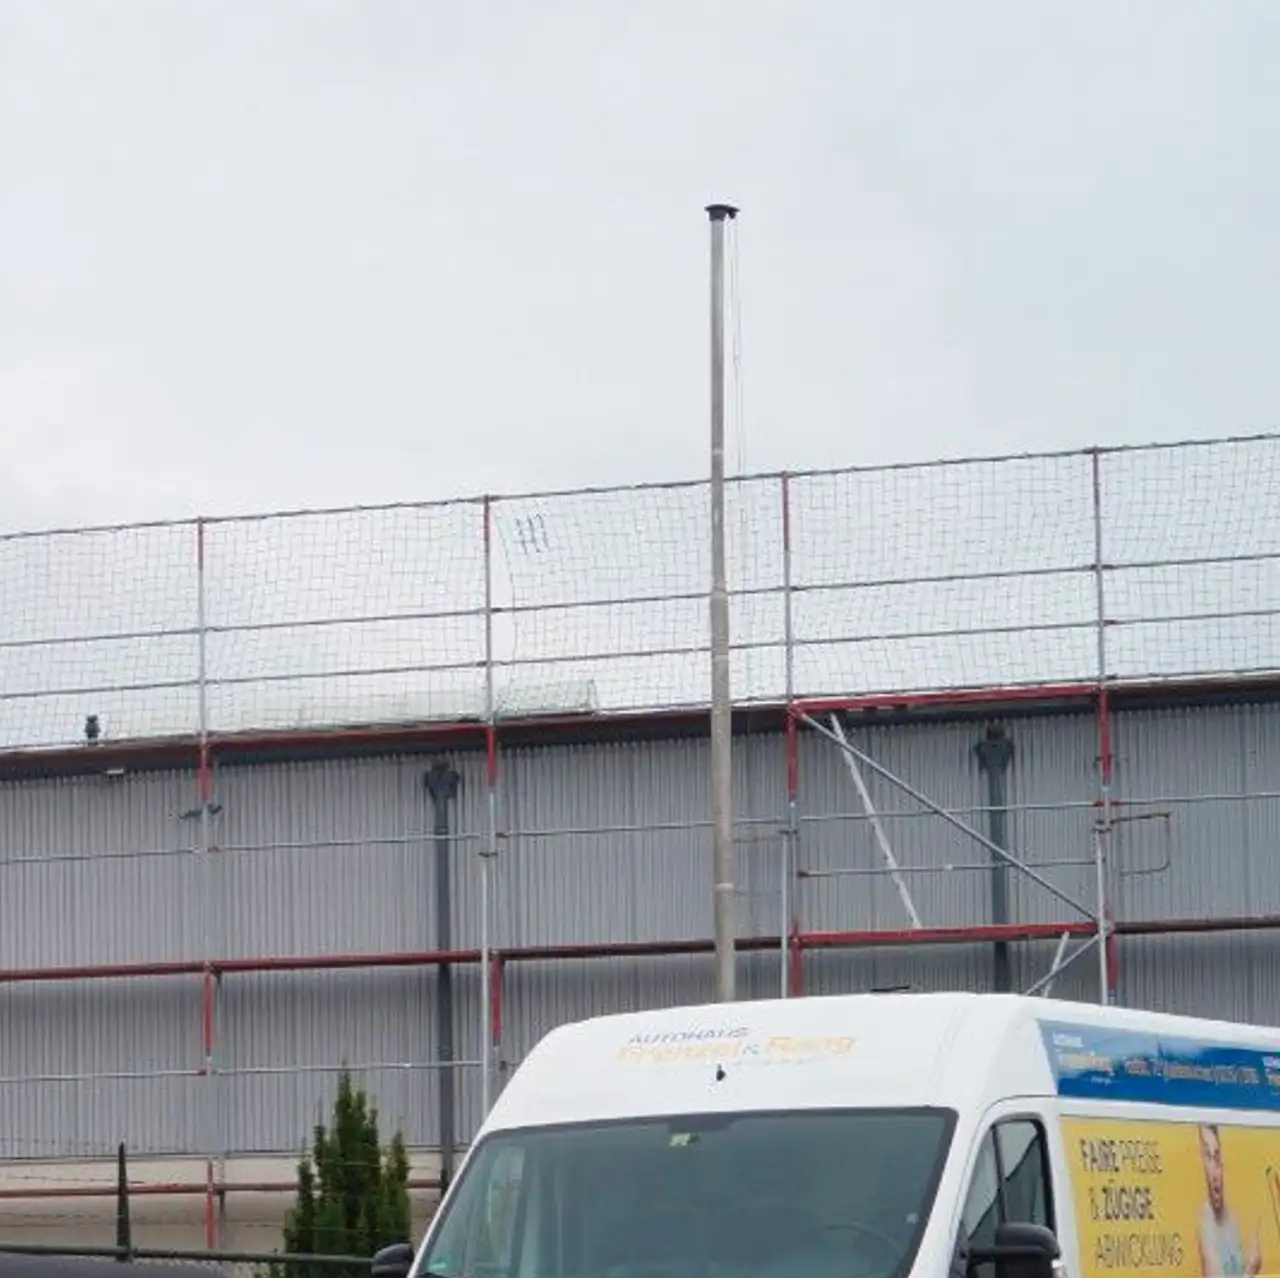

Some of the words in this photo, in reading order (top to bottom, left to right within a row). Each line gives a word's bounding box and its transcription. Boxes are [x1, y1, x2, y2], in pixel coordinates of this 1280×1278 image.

[629, 1026, 749, 1044] AUTOHAUS
[1079, 1138, 1120, 1173] FAIRE
[1095, 1232, 1183, 1268] ABWICKLUNG
